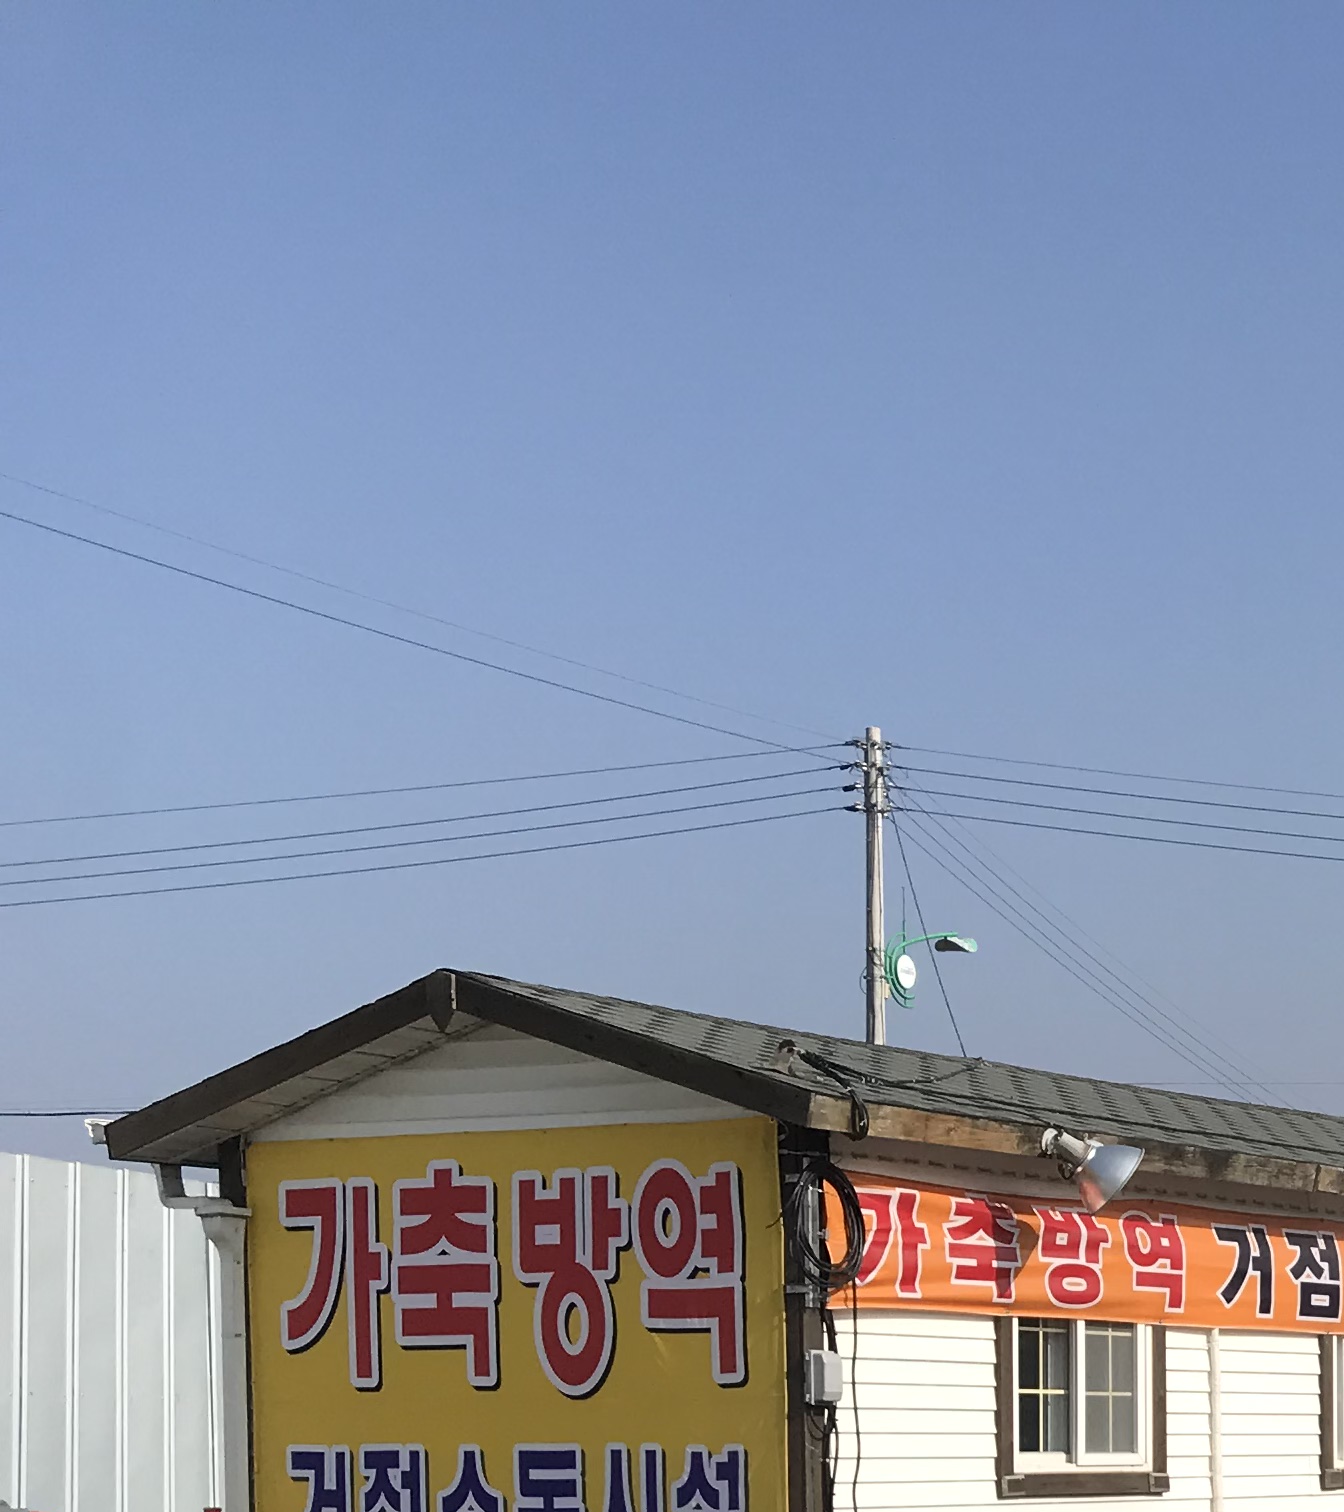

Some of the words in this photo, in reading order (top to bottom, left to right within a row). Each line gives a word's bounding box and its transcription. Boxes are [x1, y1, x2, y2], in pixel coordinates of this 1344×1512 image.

[279, 1157, 747, 1398] 가축방역
[854, 1186, 1187, 1314] 가축방역
[1211, 1222, 1343, 1323] 거점
